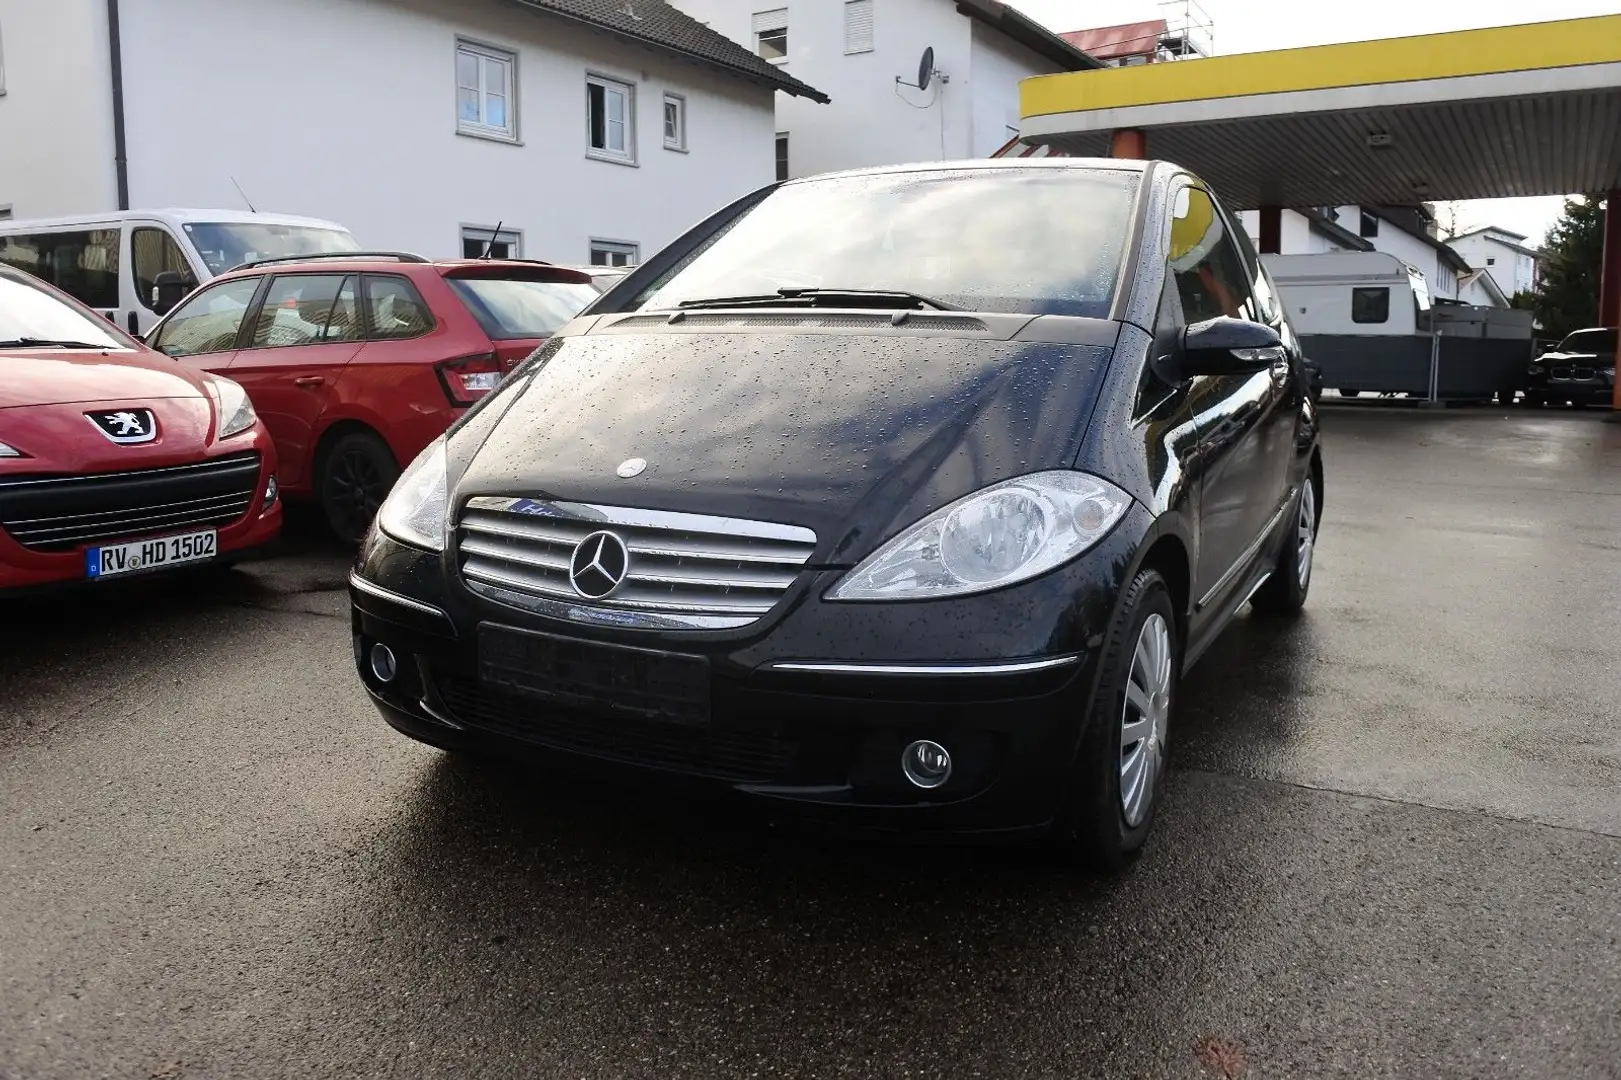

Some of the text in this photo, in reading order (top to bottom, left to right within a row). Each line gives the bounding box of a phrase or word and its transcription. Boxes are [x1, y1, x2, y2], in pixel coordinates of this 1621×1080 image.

[101, 533, 214, 572] RV HD 1502
